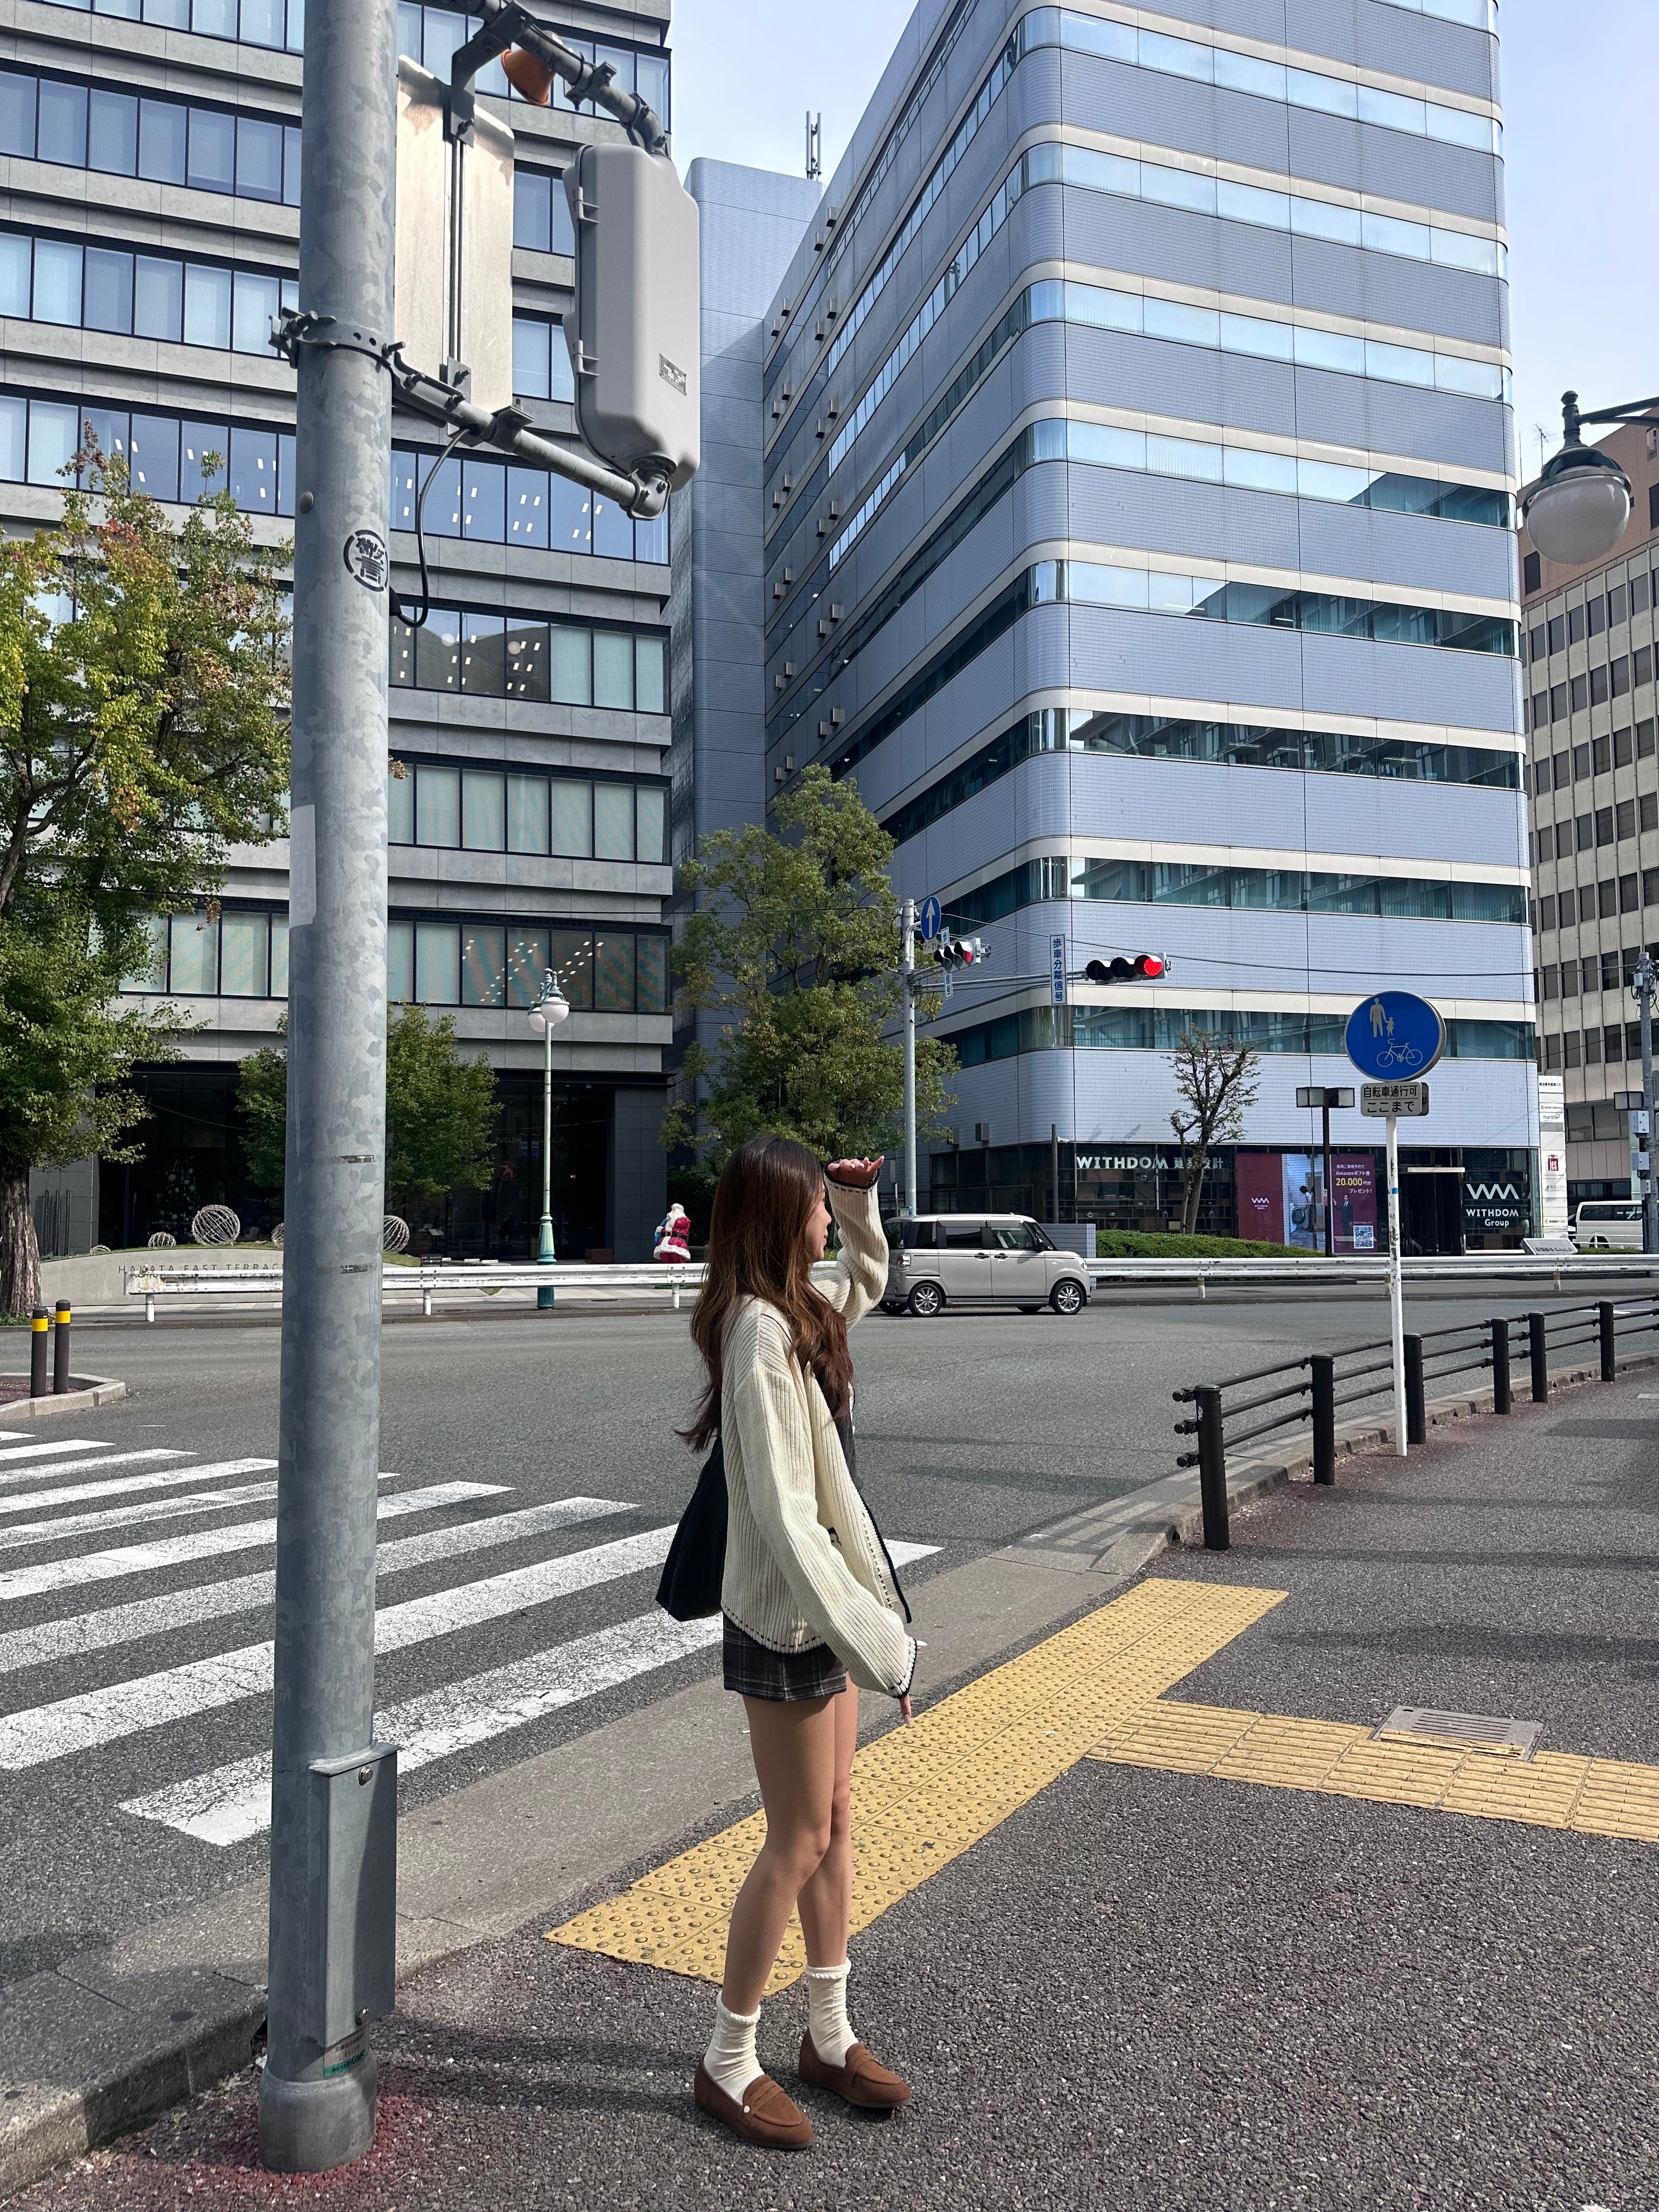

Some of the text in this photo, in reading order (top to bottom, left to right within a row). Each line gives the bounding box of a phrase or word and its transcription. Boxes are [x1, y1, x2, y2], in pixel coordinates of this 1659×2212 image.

[1052, 938, 1064, 1001] 歩車分離信号
[1363, 1085, 1418, 1098] 自転車通行可
[1367, 1101, 1415, 1113] ここまで
[1076, 1156, 1169, 1169] WITHDOM
[1466, 1209, 1519, 1217] WITHDOM
[1485, 1218, 1509, 1228] Group
